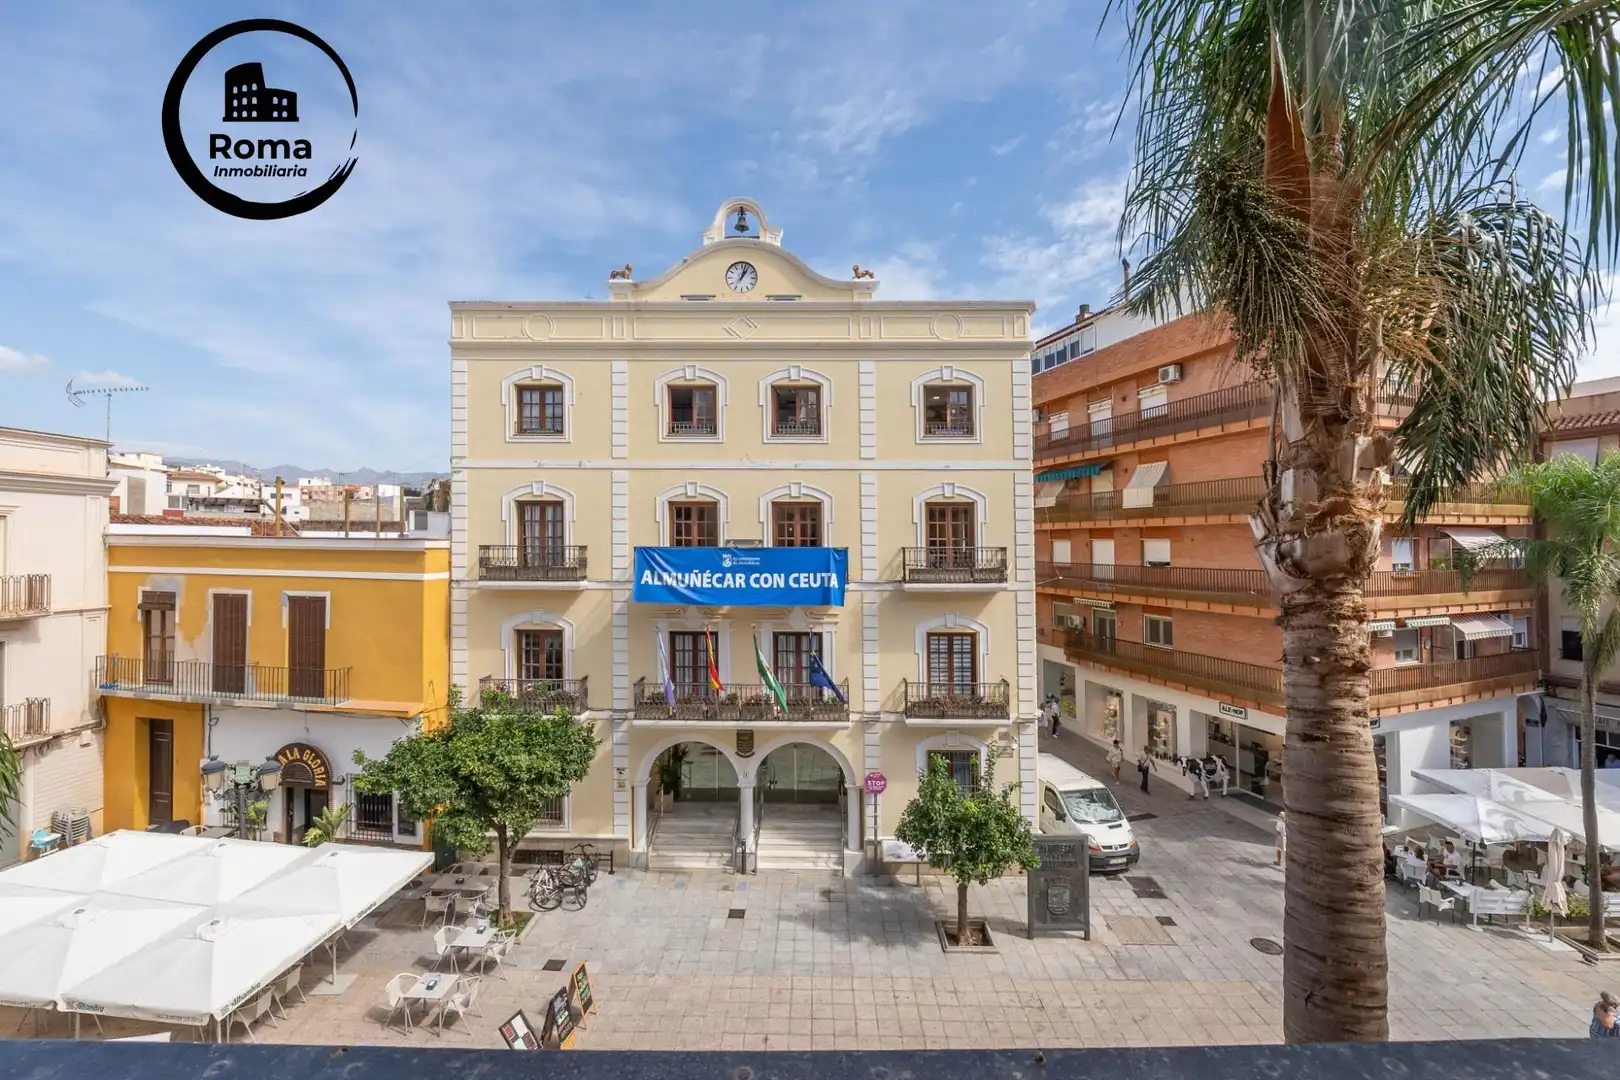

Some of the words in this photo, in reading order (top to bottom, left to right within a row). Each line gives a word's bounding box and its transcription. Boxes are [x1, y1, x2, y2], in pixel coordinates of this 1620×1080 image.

[640, 569, 746, 589] ALMUÑÉCAR
[750, 572, 786, 589] CON
[788, 572, 838, 588] CEUTA
[286, 747, 301, 761] LA
[302, 749, 326, 787] GLORIA
